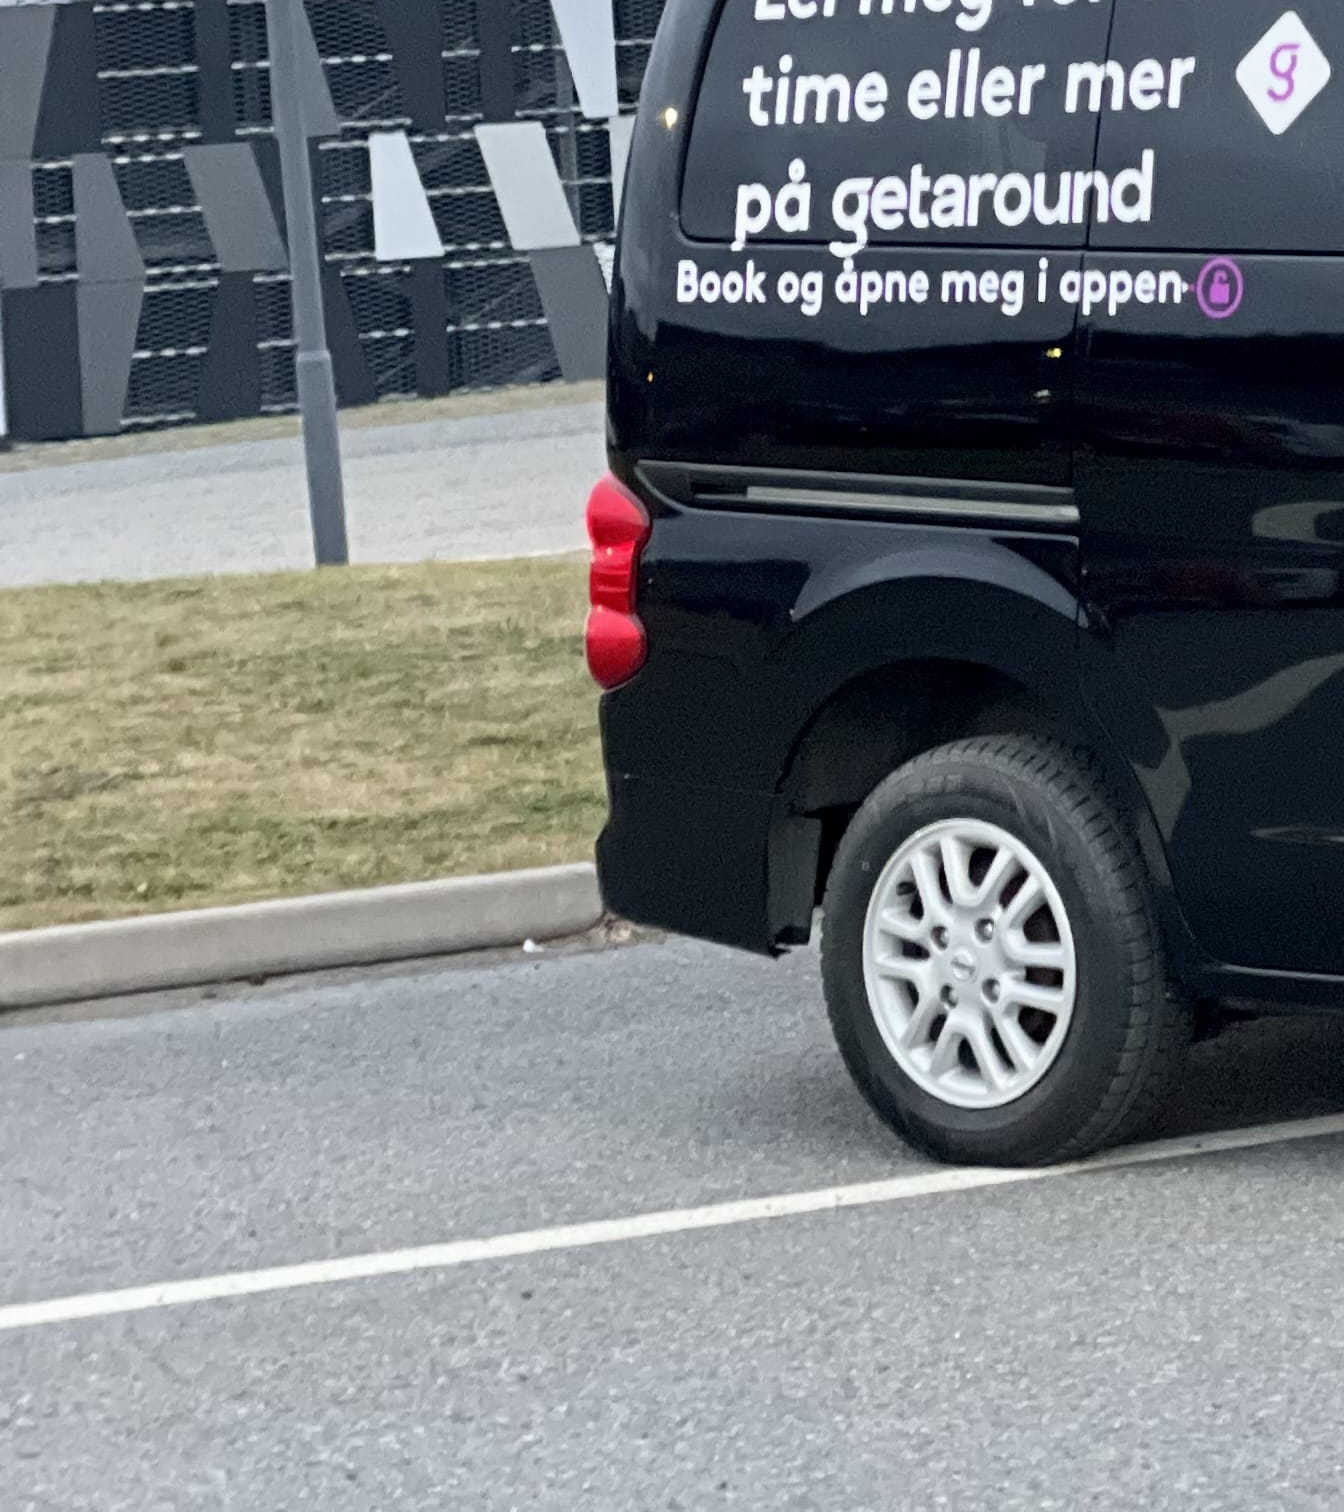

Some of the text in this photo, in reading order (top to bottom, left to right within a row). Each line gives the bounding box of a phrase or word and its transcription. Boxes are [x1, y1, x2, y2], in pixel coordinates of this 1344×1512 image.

[742, 47, 1196, 127] time eller mer
[730, 148, 1155, 257] på getaround
[676, 256, 1182, 317] Book og åpne meg i appen
